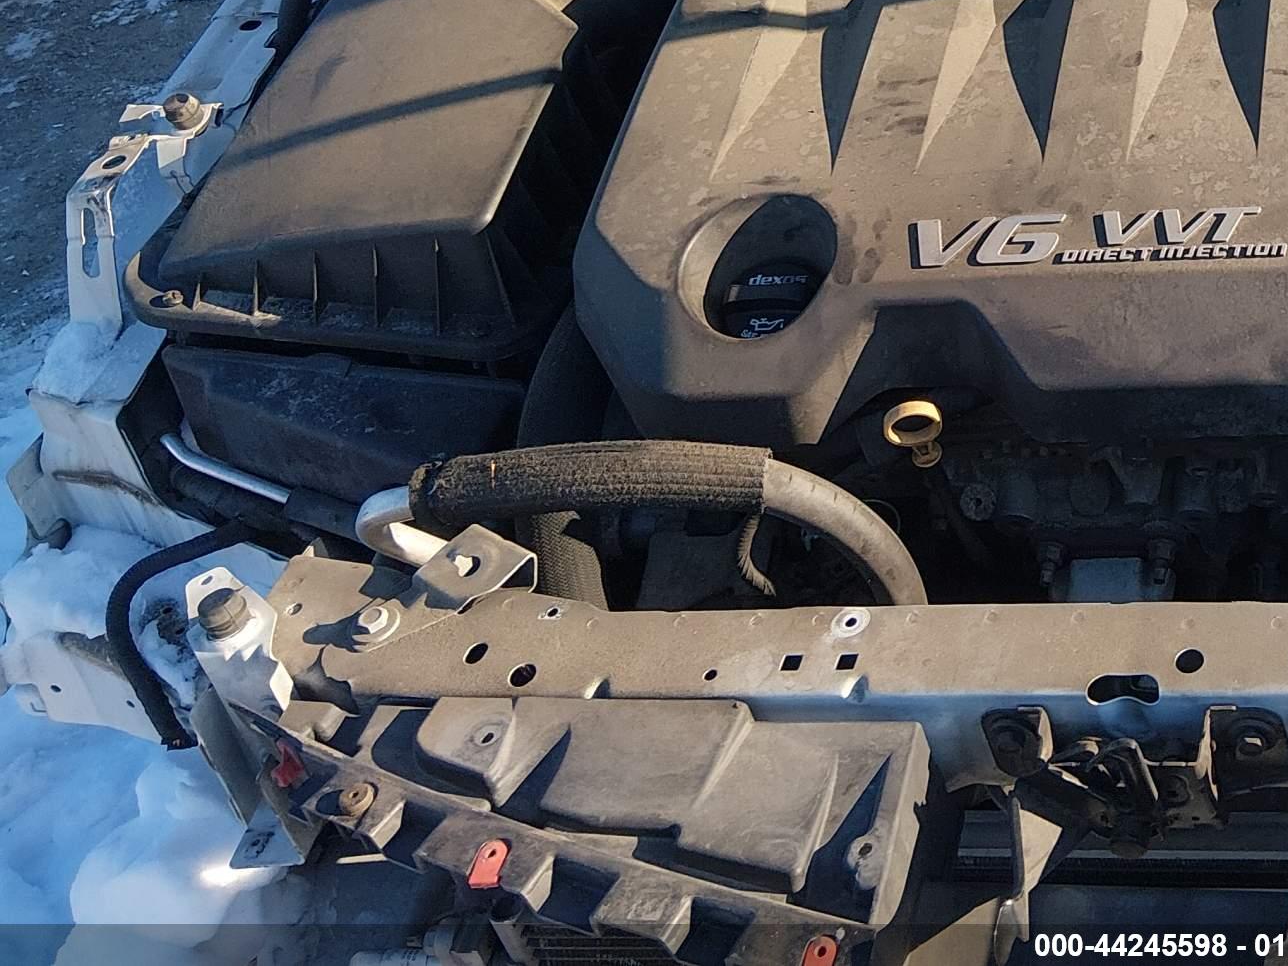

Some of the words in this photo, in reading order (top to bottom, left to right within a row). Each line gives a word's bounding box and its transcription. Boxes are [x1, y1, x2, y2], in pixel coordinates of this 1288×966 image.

[909, 213, 1067, 269] V6
[1093, 206, 1262, 247] VVT
[1060, 246, 1152, 264] DIRECT
[1159, 242, 1288, 261] INJECTION
[747, 274, 808, 286] dexos
